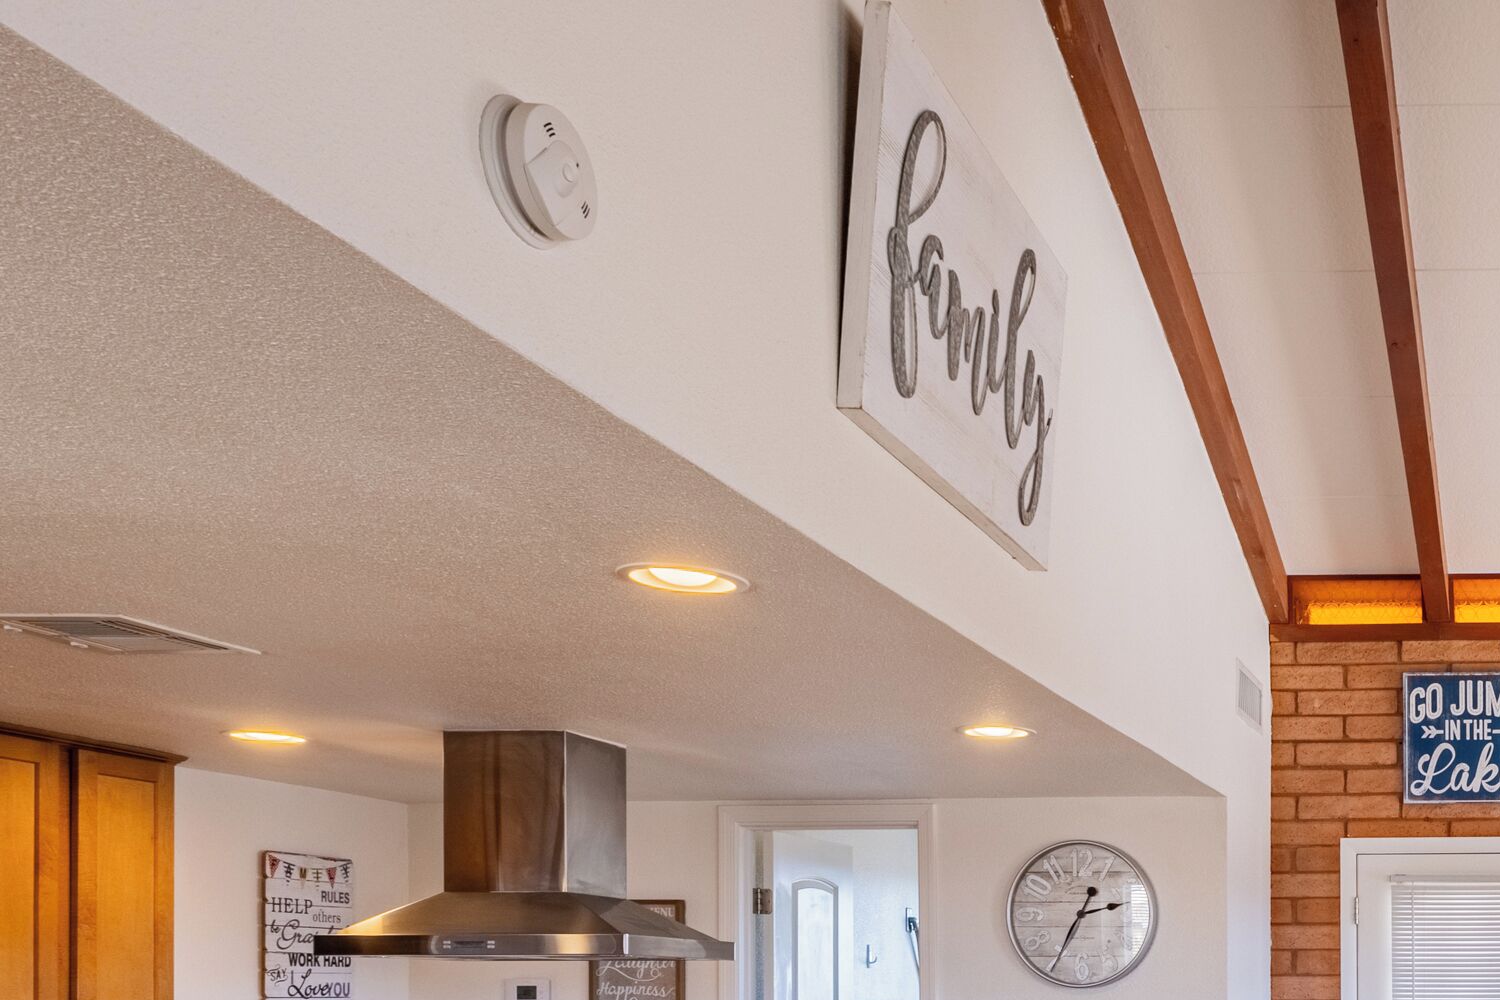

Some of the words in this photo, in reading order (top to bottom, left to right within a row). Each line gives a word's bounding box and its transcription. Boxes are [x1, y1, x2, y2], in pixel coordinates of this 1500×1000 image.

[887, 110, 1054, 526] family
[1409, 683, 1443, 724] GO
[1445, 719, 1460, 740] IN
[1463, 719, 1492, 740] THE
[1042, 854, 1070, 885] 11
[1071, 849, 1094, 877] 12
[1098, 855, 1115, 882] 1
[321, 890, 350, 904] RULES
[1023, 874, 1052, 902] 10
[271, 897, 313, 914] HELP
[312, 910, 342, 923] others
[1015, 907, 1044, 921] 9
[270, 919, 280, 933] be
[1024, 930, 1050, 950] 8
[288, 952, 321, 967] WORK
[323, 956, 352, 967] HARD
[1075, 952, 1090, 981] 6
[270, 968, 287, 981] SAY
[288, 968, 330, 999] Love
[290, 970, 294, 985] I
[328, 982, 350, 997] YOU
